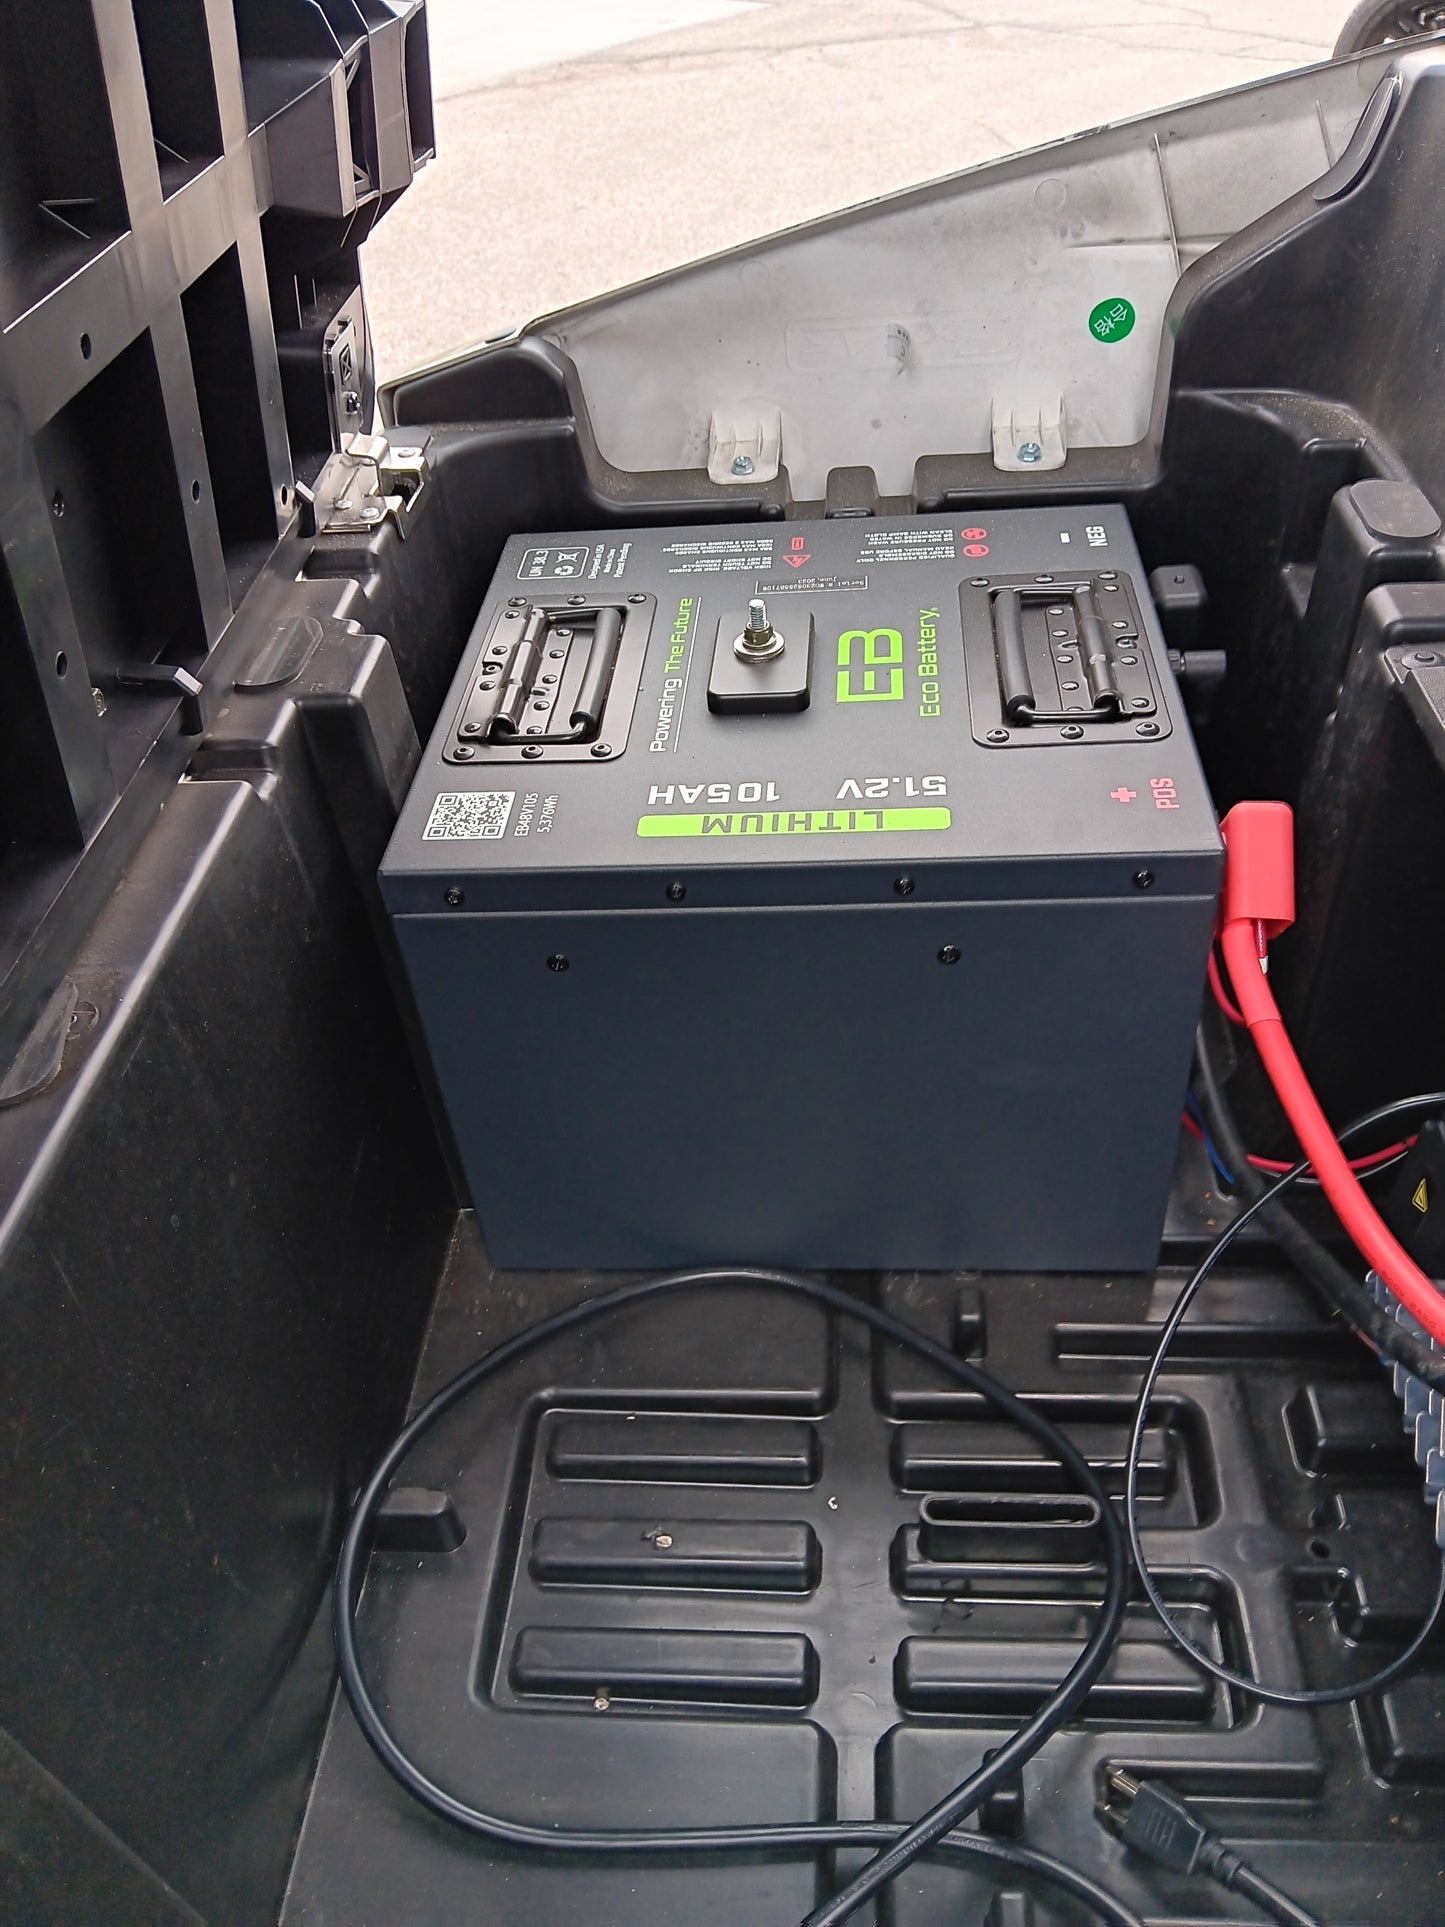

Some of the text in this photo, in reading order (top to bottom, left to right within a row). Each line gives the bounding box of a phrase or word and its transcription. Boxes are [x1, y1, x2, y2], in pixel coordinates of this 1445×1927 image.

[1094, 303, 1128, 336] 合格
[1086, 526, 1108, 546] NEG
[529, 550, 549, 576] UN 38.3
[613, 543, 632, 577] Patent Pending
[649, 596, 693, 752] Powering The Future
[919, 681, 941, 717] Eco
[646, 775, 948, 805] 51.2V 105AH
[1150, 778, 1180, 808] POS
[514, 792, 539, 836] EB48V105
[536, 794, 560, 833] 5,376Wh
[701, 810, 884, 834] LITHIUM
